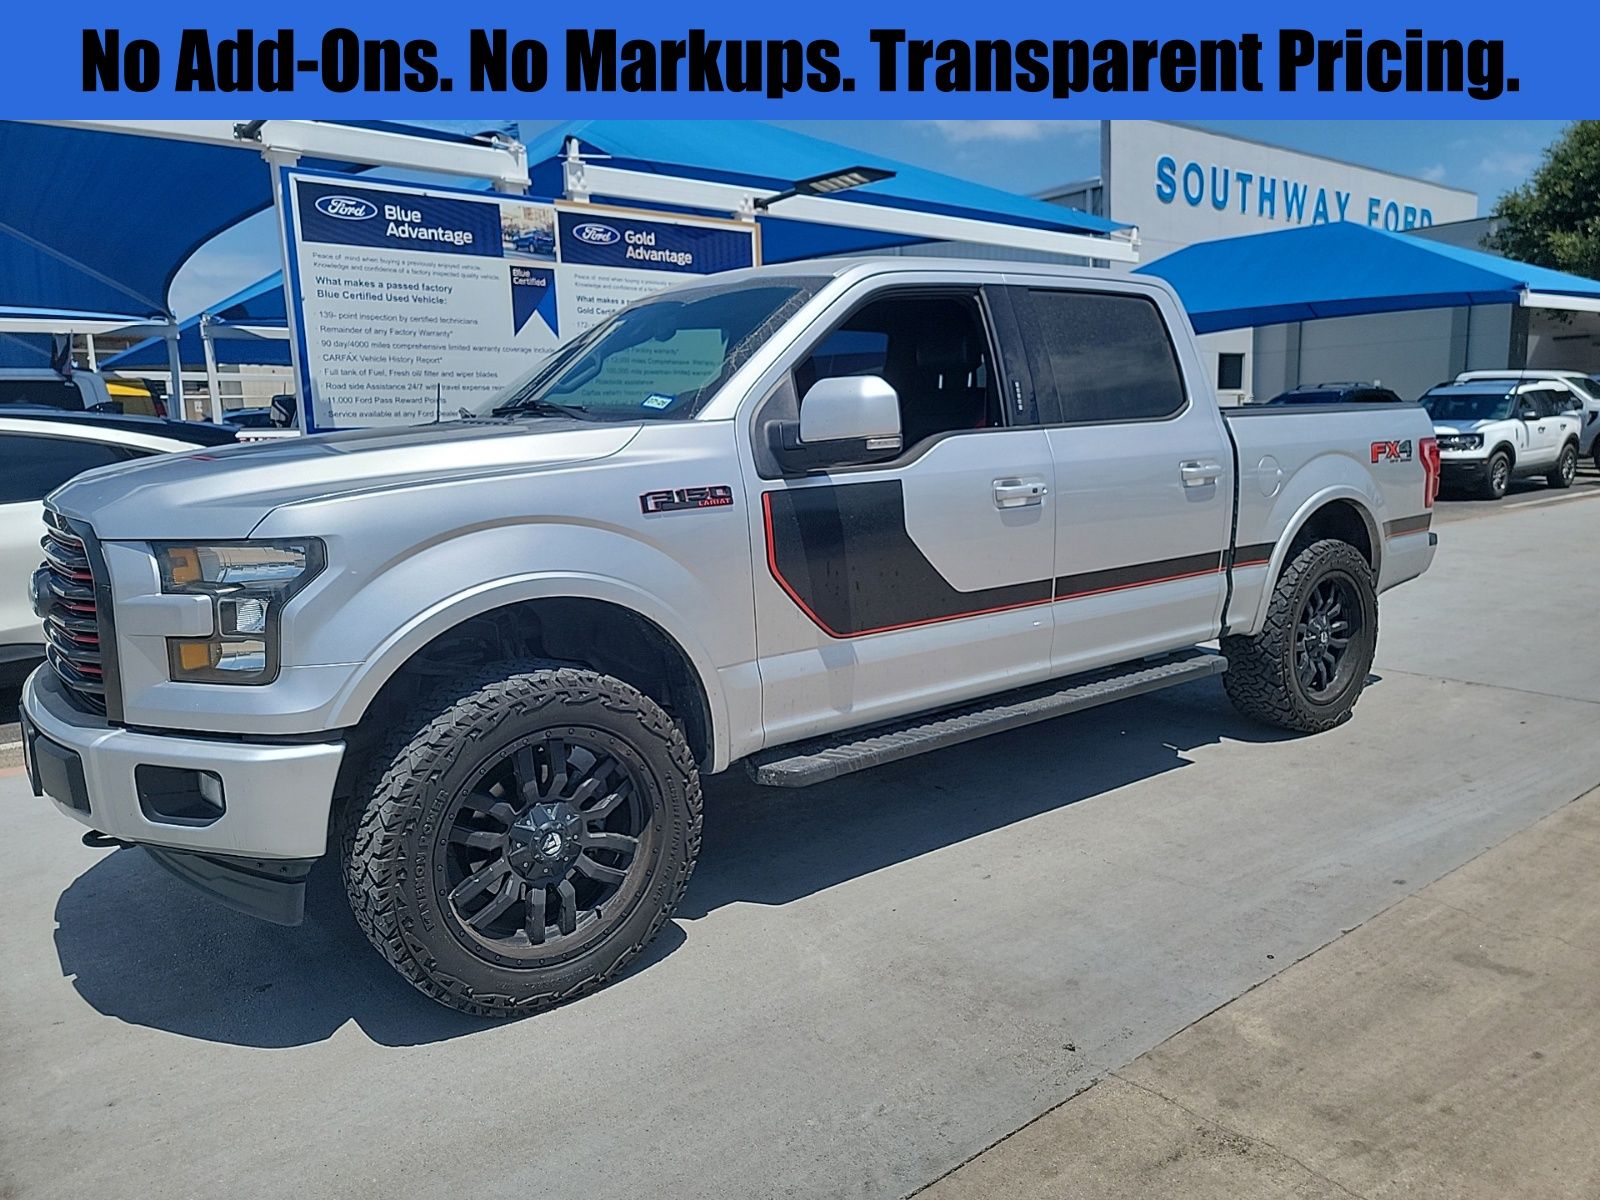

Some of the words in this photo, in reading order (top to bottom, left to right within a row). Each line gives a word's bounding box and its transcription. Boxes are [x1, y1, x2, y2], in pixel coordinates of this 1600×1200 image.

[1156, 155, 1350, 224] SOUTHWAY
[1367, 197, 1433, 232] FORD
[328, 199, 366, 218] Ford
[384, 205, 421, 223] Blue
[386, 222, 473, 245] Advantage
[583, 225, 611, 242] Ford
[624, 230, 655, 246] Gold
[626, 246, 693, 266] Advantage
[512, 268, 531, 278] Blue
[315, 276, 341, 286] What
[344, 278, 375, 288] makes
[386, 281, 419, 291] passed
[422, 283, 453, 294] factory
[513, 277, 546, 287] Certified
[316, 289, 340, 299] Blue
[342, 290, 383, 301] Certified
[386, 293, 409, 303] Used
[412, 295, 448, 305] Vehicle:
[576, 295, 595, 304] What
[596, 297, 619, 305] makes
[577, 306, 595, 315] Gold
[338, 312, 358, 322] point
[359, 313, 397, 323] inspection
[399, 314, 408, 324] by
[410, 315, 438, 324] certified
[440, 316, 478, 325] technicians
[320, 325, 363, 334] Remainder
[365, 326, 373, 334] of
[374, 329, 388, 337] any
[389, 327, 417, 337] Factory
[321, 340, 332, 348] 90
[333, 340, 369, 349] day/4000
[371, 341, 390, 349] miles
[392, 342, 447, 352] comprehensive
[448, 343, 471, 351] limited
[472, 345, 501, 353] warranty
[322, 354, 358, 362] CARFAX
[359, 354, 387, 363] Vehicle
[389, 355, 414, 365] History
[340, 368, 357, 377] tank
[359, 368, 367, 377] of
[389, 369, 410, 377] Fresh
[423, 370, 440, 378] filter
[441, 370, 454, 378] and
[456, 371, 474, 380] wiper
[476, 370, 498, 378] blades
[325, 382, 346, 390] Road
[349, 382, 365, 390] side
[366, 382, 406, 390] Assistance
[408, 382, 423, 390] 24/7
[462, 384, 490, 393] expense
[355, 396, 372, 404] Ford
[374, 396, 392, 404] Pass
[394, 396, 426, 404] Reward
[328, 410, 357, 418] Service
[359, 410, 392, 418] available
[394, 410, 401, 418] at
[403, 411, 416, 419] any
[417, 410, 434, 418] Ford
[1371, 440, 1412, 463] FX4
[698, 497, 731, 507] LARIAT
